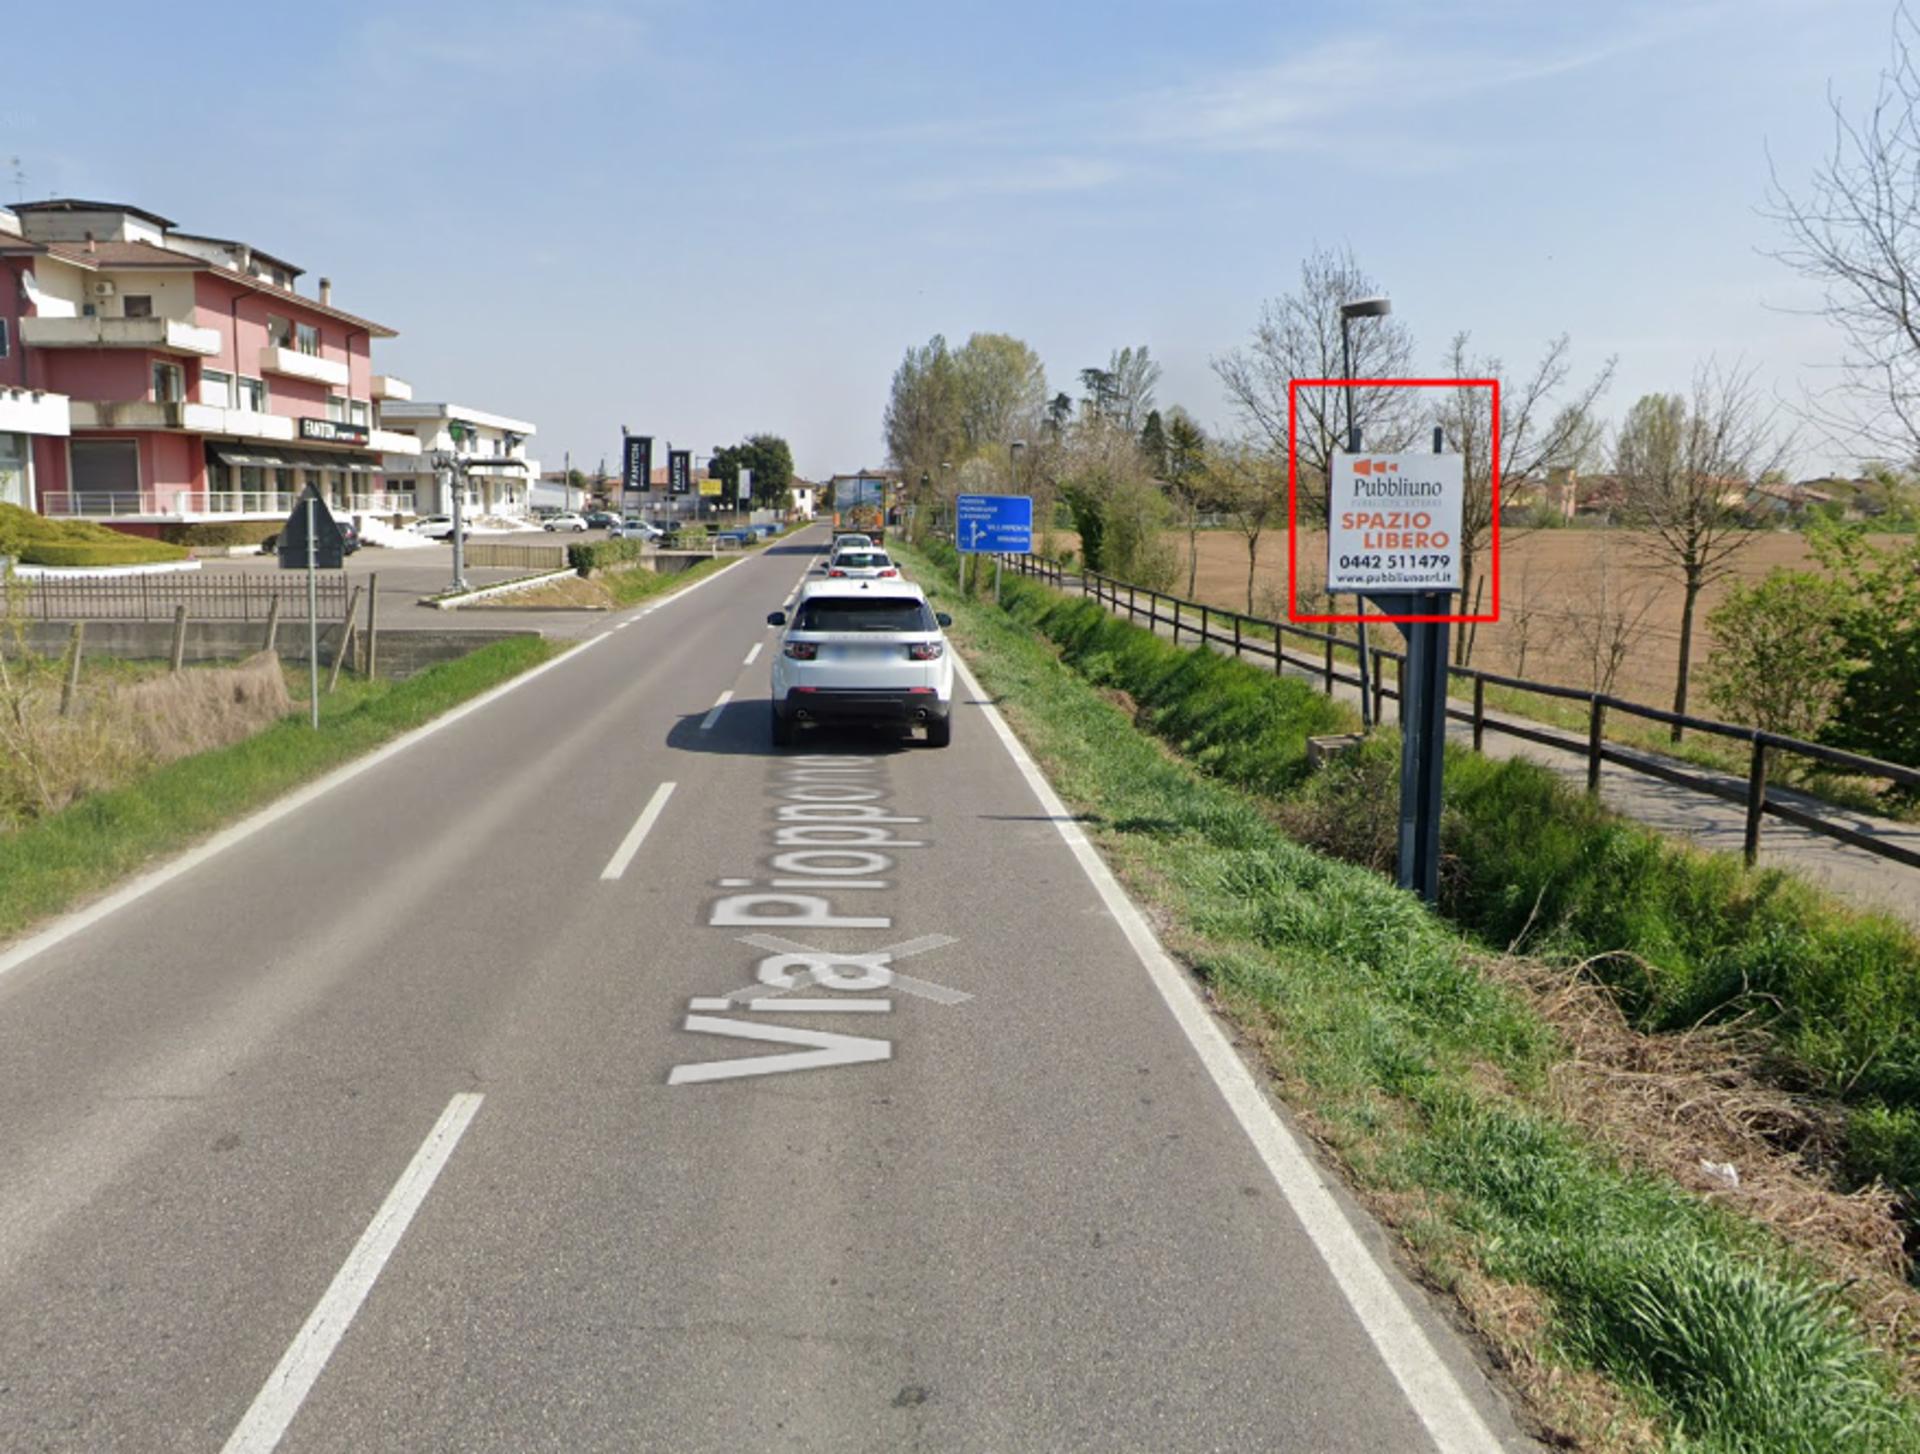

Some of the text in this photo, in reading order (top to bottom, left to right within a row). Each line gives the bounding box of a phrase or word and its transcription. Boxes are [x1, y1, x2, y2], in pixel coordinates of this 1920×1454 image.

[1353, 478, 1442, 497] Pubbliuno
[1341, 512, 1432, 530] SPAZIO
[1363, 531, 1450, 549] LIBERO
[1339, 554, 1451, 569] 0442 511479
